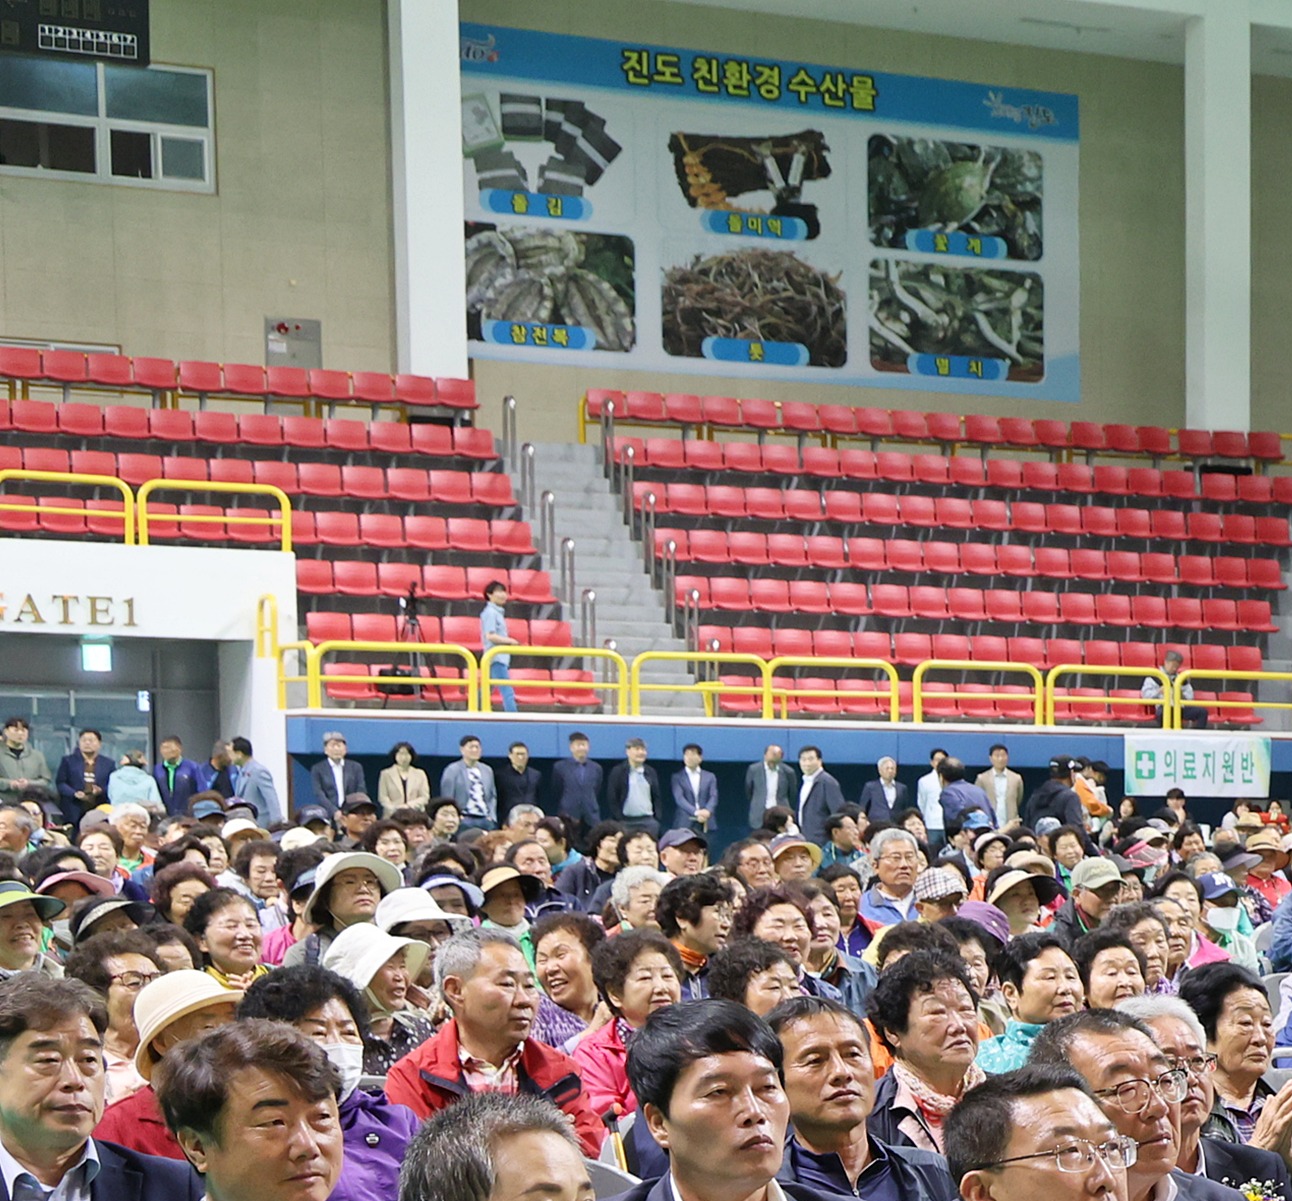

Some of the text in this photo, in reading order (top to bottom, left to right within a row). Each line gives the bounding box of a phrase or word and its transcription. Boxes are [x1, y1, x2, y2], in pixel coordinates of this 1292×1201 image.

[58, 27, 66, 37] 2
[71, 29, 79, 39] 3
[84, 30, 92, 40] 4
[111, 33, 119, 43] 6
[622, 49, 877, 111] 진도 친환경 수산물
[511, 324, 569, 346] 참전복
[0, 592, 138, 627] ATE1
[1163, 750, 1255, 784] 의료지원반
